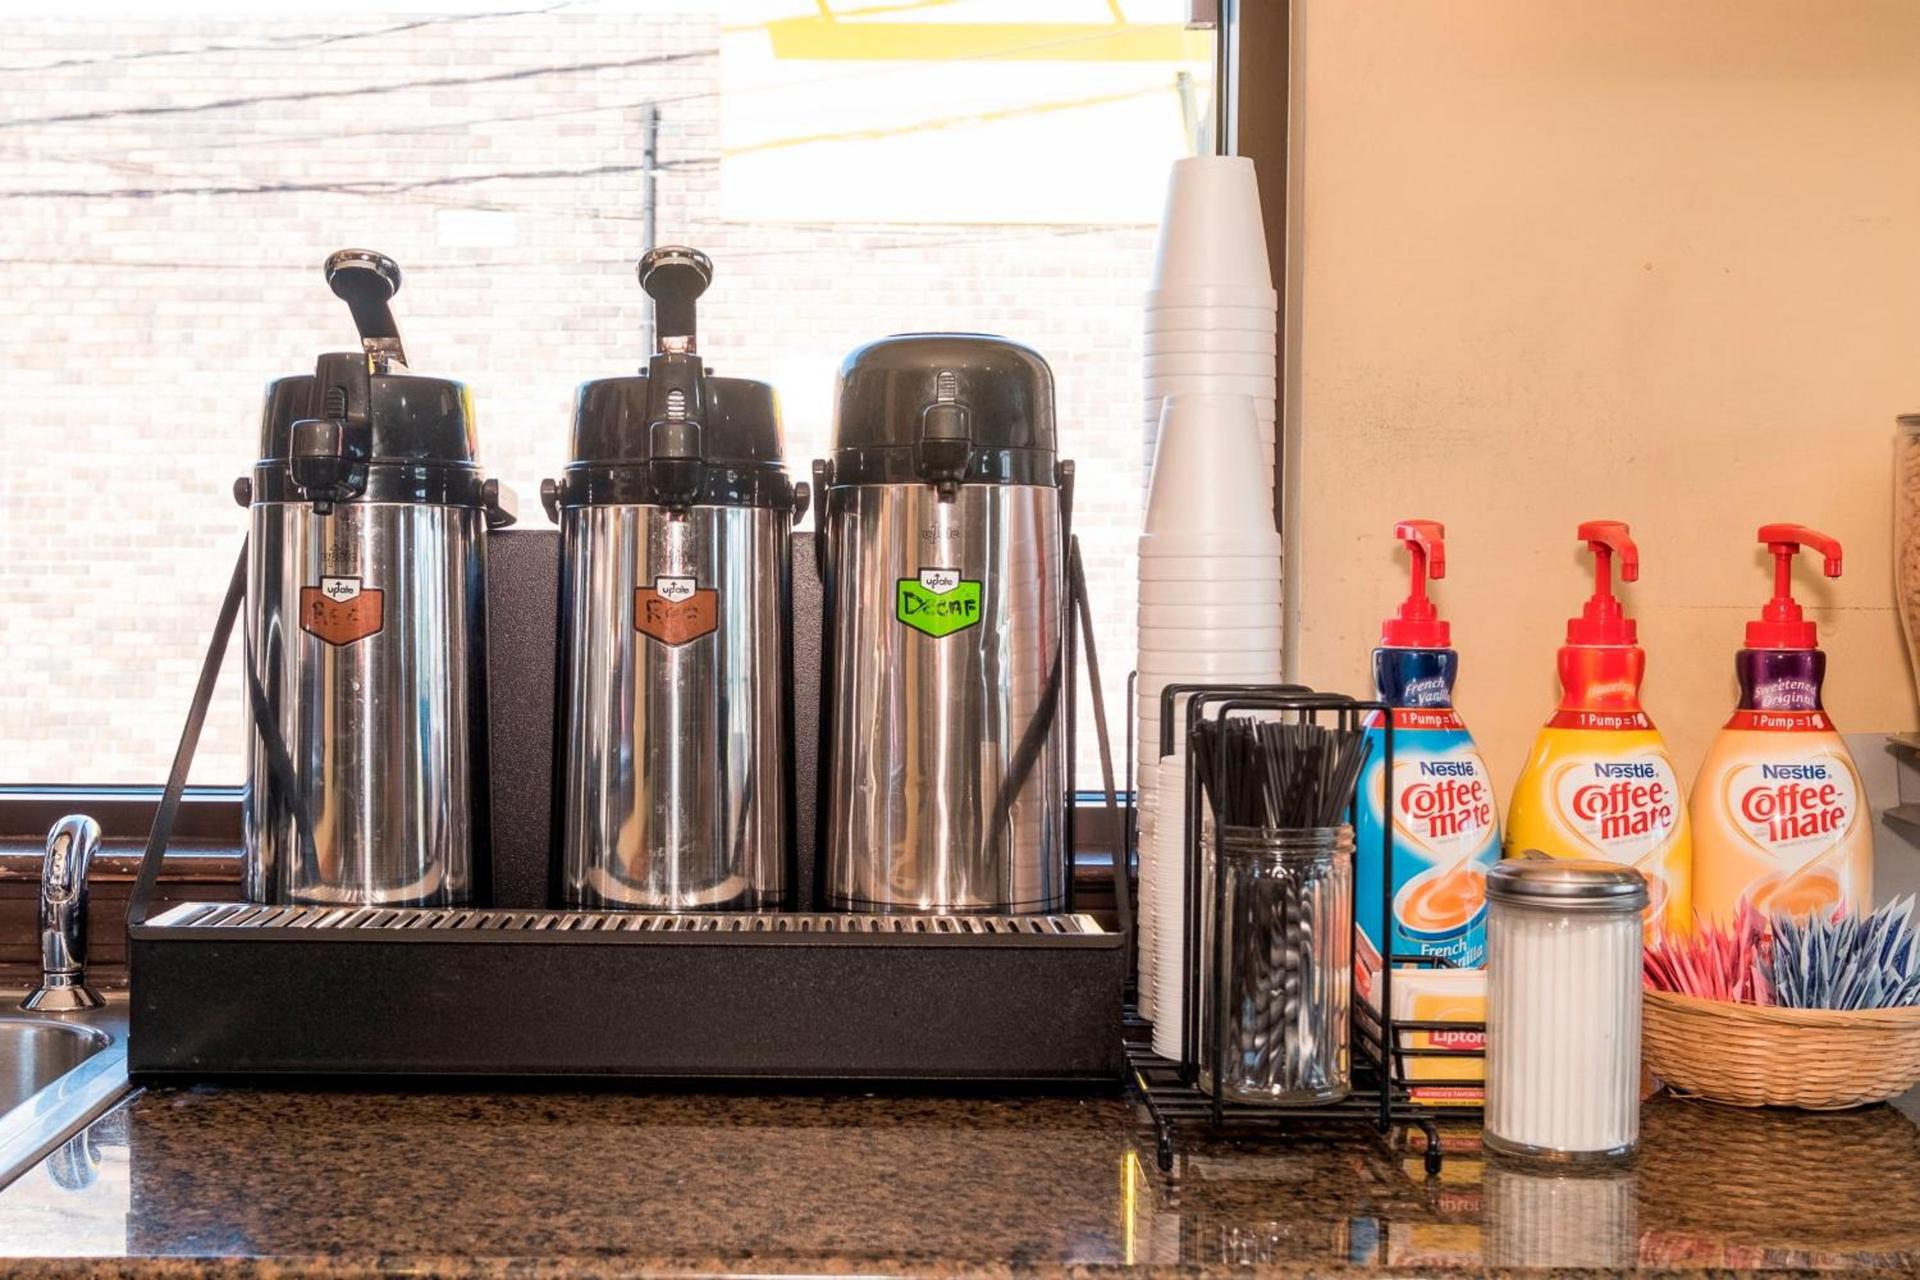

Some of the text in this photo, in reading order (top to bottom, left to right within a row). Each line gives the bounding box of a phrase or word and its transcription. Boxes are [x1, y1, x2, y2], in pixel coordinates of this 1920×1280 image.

[1404, 676, 1445, 697] French
[1410, 712, 1442, 727] Pump
[1589, 713, 1622, 729] Pump
[1761, 715, 1794, 731] Pump
[1600, 804, 1672, 840] mate
[1421, 937, 1468, 957] French
